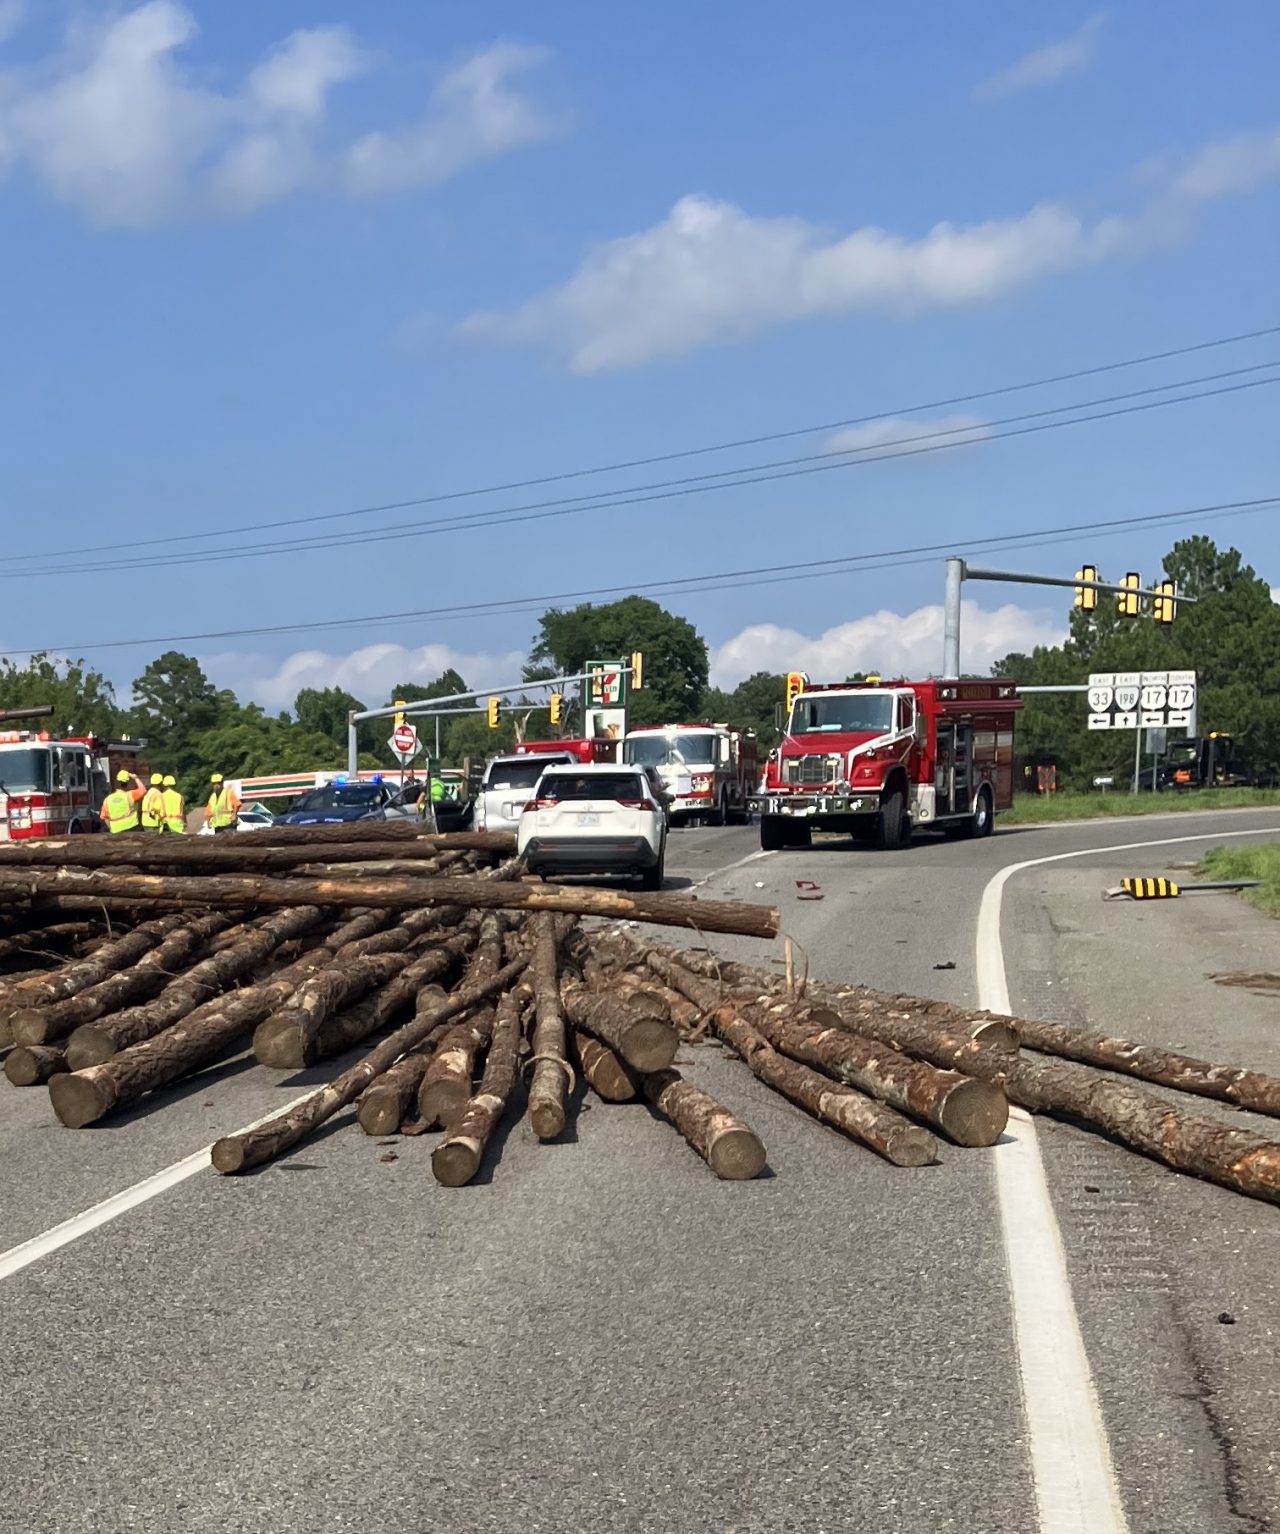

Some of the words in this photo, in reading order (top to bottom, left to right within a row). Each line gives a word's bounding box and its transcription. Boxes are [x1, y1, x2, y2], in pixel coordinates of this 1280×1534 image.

[1119, 675, 1136, 683] EAST
[1143, 674, 1167, 682] NORTH
[1170, 673, 1193, 681] SOUTH
[1093, 692, 1109, 706] 33
[1119, 693, 1135, 705] 198
[1146, 691, 1162, 704] 17
[1173, 690, 1189, 703] 17
[769, 799, 779, 813] R
[819, 798, 828, 813] 1
